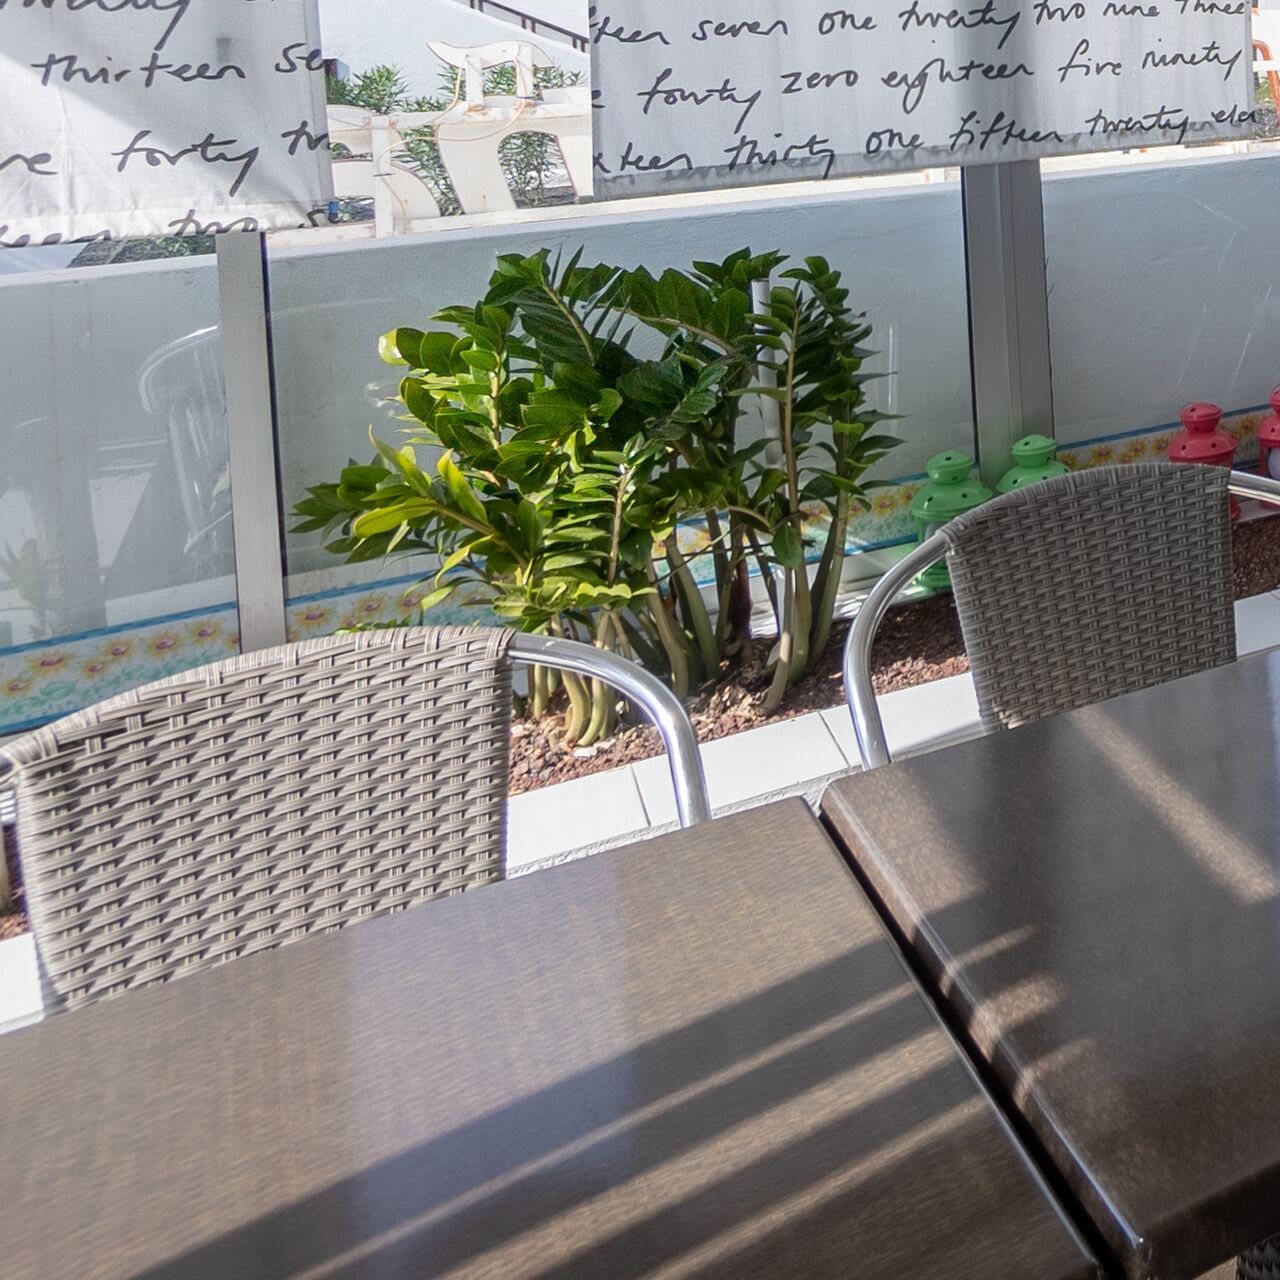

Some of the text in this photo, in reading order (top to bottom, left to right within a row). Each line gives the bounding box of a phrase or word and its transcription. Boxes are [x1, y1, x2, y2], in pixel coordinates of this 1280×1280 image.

[692, 20, 788, 41] seven
[818, 10, 877, 35] one
[898, 0, 1020, 50] twenty
[30, 52, 246, 88] thirteen
[780, 70, 858, 94] zero
[881, 38, 1034, 115] eighteen
[1058, 39, 1122, 83] five
[1142, 38, 1242, 81] ninety
[111, 130, 259, 197] forty
[724, 133, 835, 180] thirty
[865, 129, 925, 155] one
[949, 111, 1064, 152] fifteen
[1084, 105, 1190, 145] twenty
